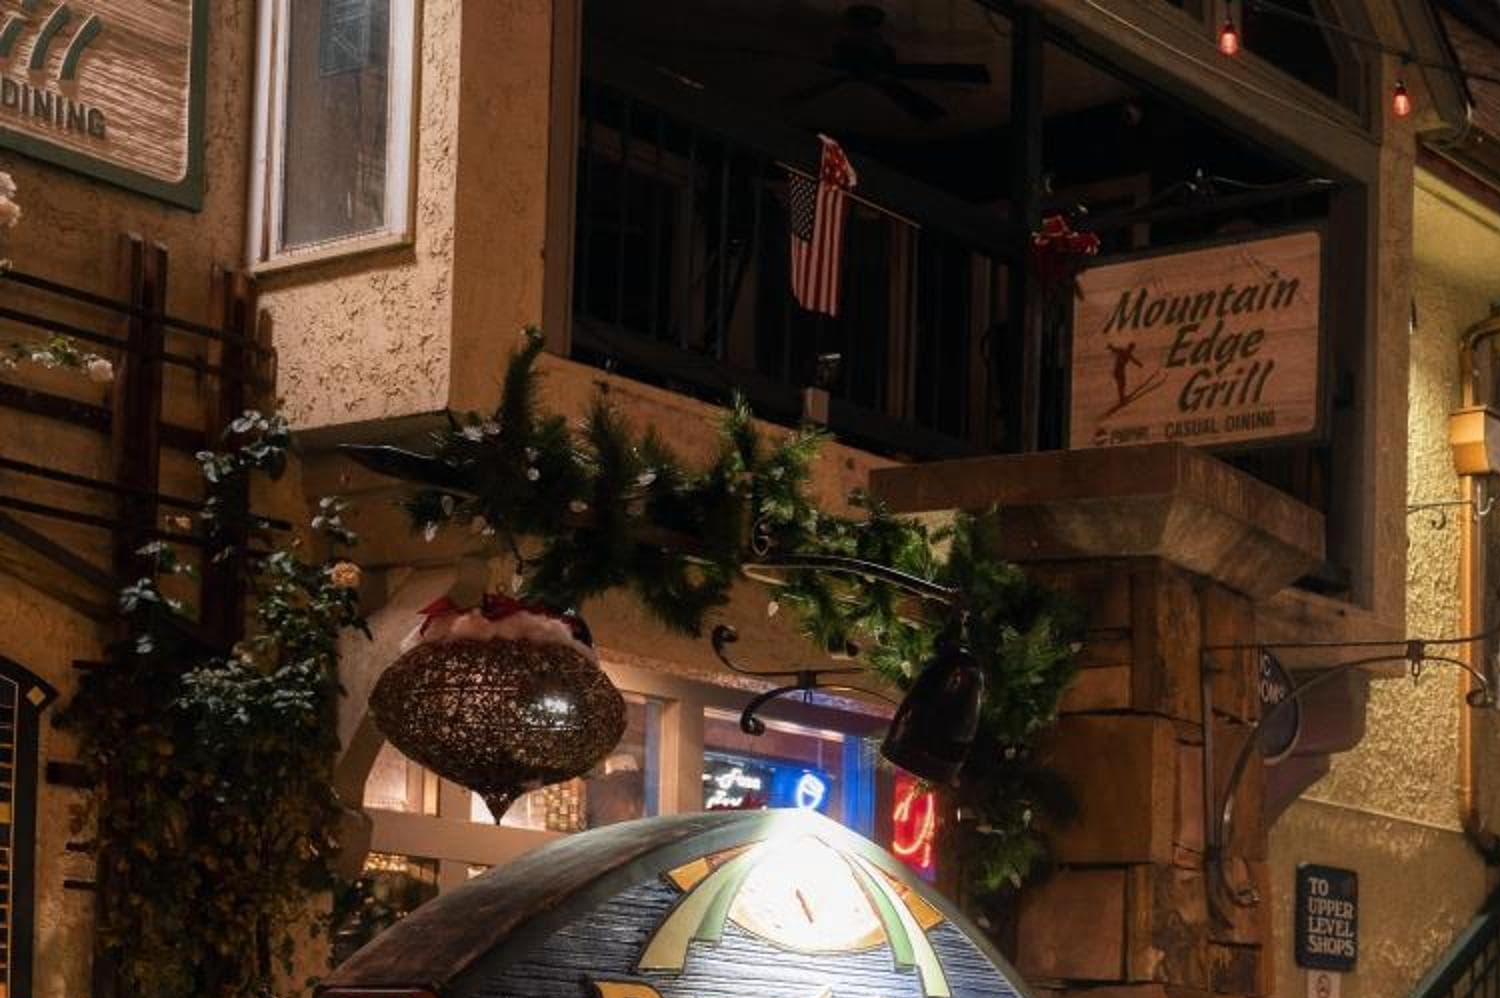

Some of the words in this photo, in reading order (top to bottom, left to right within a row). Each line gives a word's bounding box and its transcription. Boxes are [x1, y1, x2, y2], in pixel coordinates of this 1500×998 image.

[1, 78, 106, 140] DINING
[1103, 270, 1299, 334] Mountain
[1165, 320, 1265, 374] Edge
[1178, 360, 1275, 413] Grill
[1165, 416, 1218, 440] CASUAL
[1225, 409, 1277, 433] DINING
[1308, 877, 1329, 896] TO
[1308, 896, 1353, 919] UPPER
[1308, 915, 1354, 938] LEVEL
[1308, 935, 1355, 958] SHOPS
